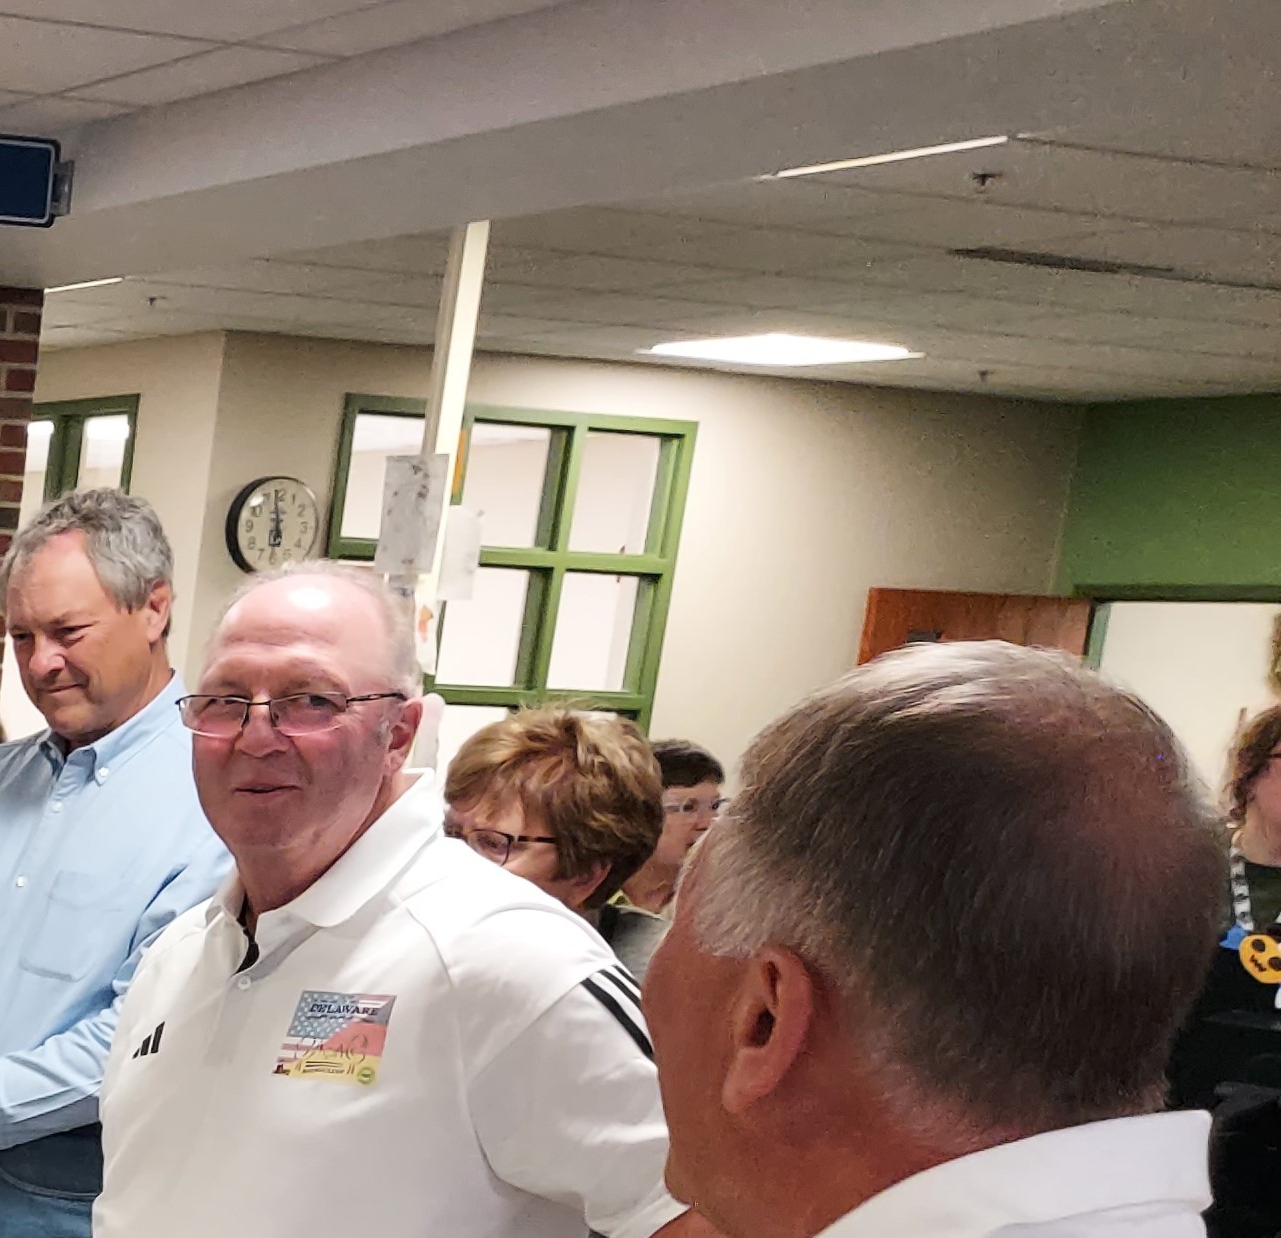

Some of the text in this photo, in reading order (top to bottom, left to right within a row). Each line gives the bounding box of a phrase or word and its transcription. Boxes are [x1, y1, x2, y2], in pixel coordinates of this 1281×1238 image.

[298, 504, 306, 517] 2
[245, 520, 254, 533] 9
[300, 521, 308, 534] 3
[248, 536, 257, 550] 8
[294, 537, 302, 549] 4
[258, 548, 265, 560] 7
[310, 1003, 379, 1016] DELAWARE
